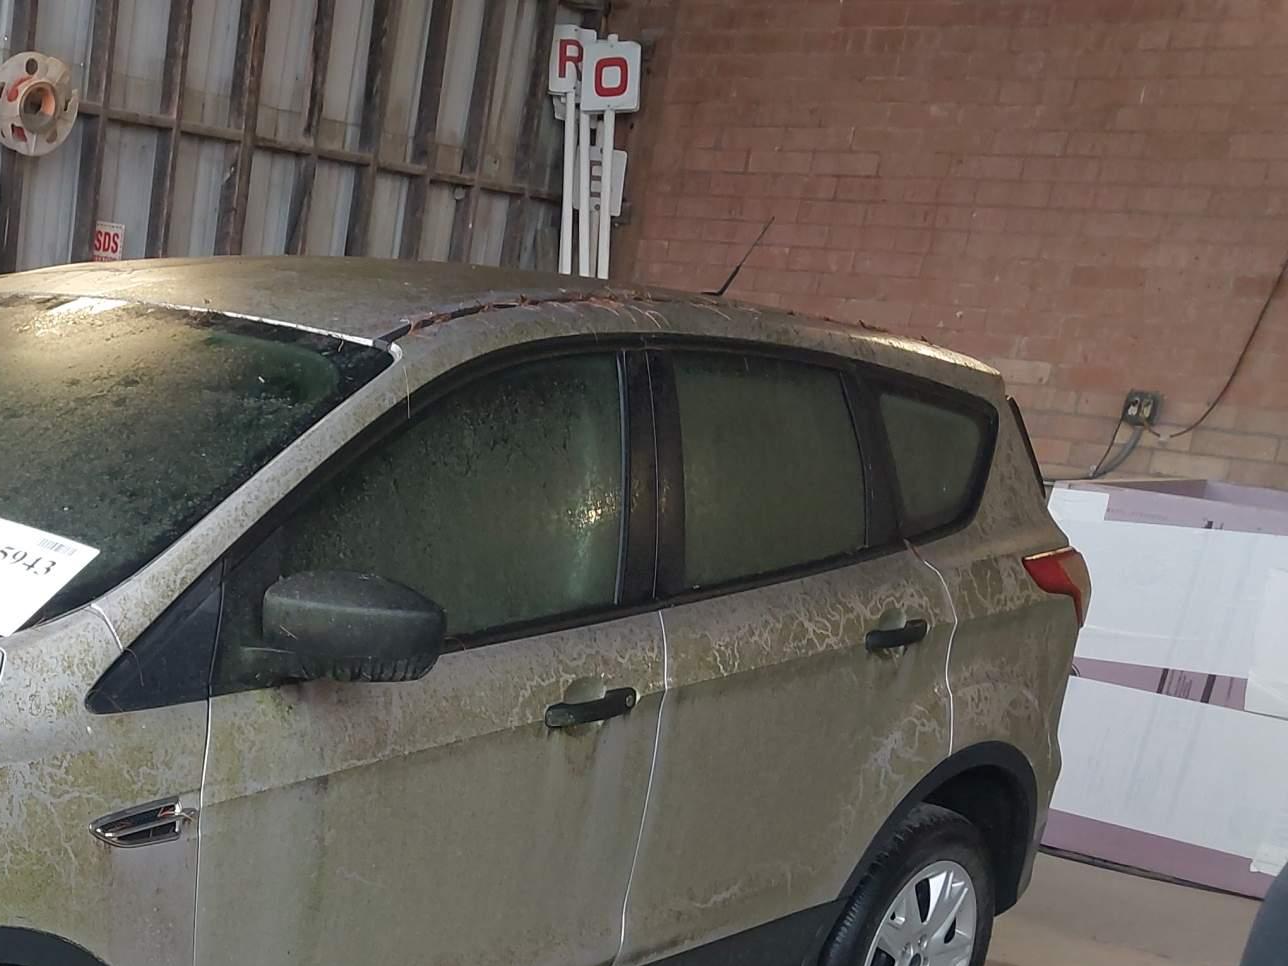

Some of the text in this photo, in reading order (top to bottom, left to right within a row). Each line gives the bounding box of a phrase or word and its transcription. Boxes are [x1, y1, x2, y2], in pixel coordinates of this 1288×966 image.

[558, 38, 584, 82] R
[594, 56, 630, 98] O
[94, 230, 120, 254] SDS
